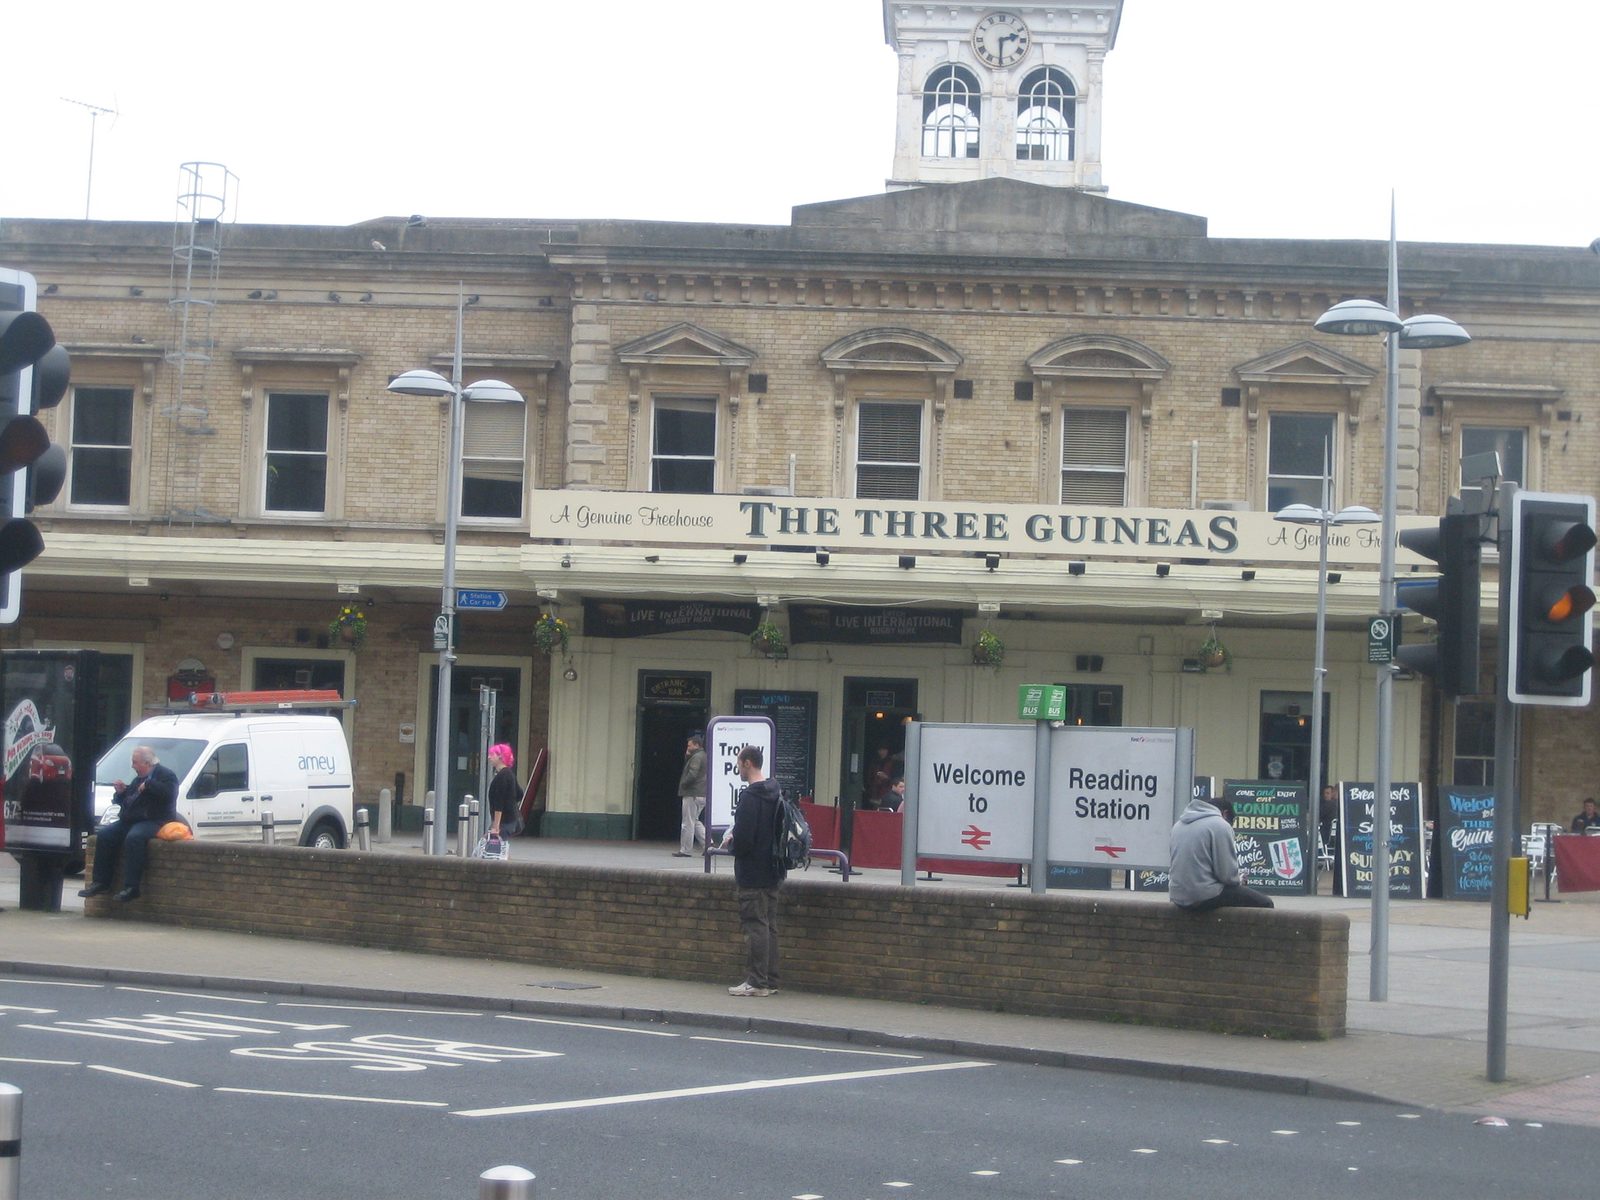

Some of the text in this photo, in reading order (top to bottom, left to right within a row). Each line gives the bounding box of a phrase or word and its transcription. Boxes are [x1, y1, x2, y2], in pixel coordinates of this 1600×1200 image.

[550, 505, 714, 528] A Genuine Freehouse
[739, 501, 1239, 555] THE THREE GUINEAS
[1267, 527, 1288, 546] A
[470, 592, 492, 600] Station
[631, 605, 753, 623] LIVE INTERNATIONAL
[835, 615, 954, 629] LIVE INTERNATIONAL
[761, 695, 791, 705] MENU
[1023, 706, 1039, 714] BUS
[1048, 707, 1061, 715] BUS
[298, 755, 335, 775] amey
[933, 762, 1026, 787] Welcome
[1069, 767, 1158, 798] Reading
[968, 793, 988, 813] to
[1075, 796, 1150, 821] Station
[1233, 802, 1301, 816] LONDON
[1449, 794, 1495, 813] Welco
[1462, 820, 1493, 828] THRE
[17, 1011, 351, 1044] TAXI
[230, 1034, 566, 1072] BUS
